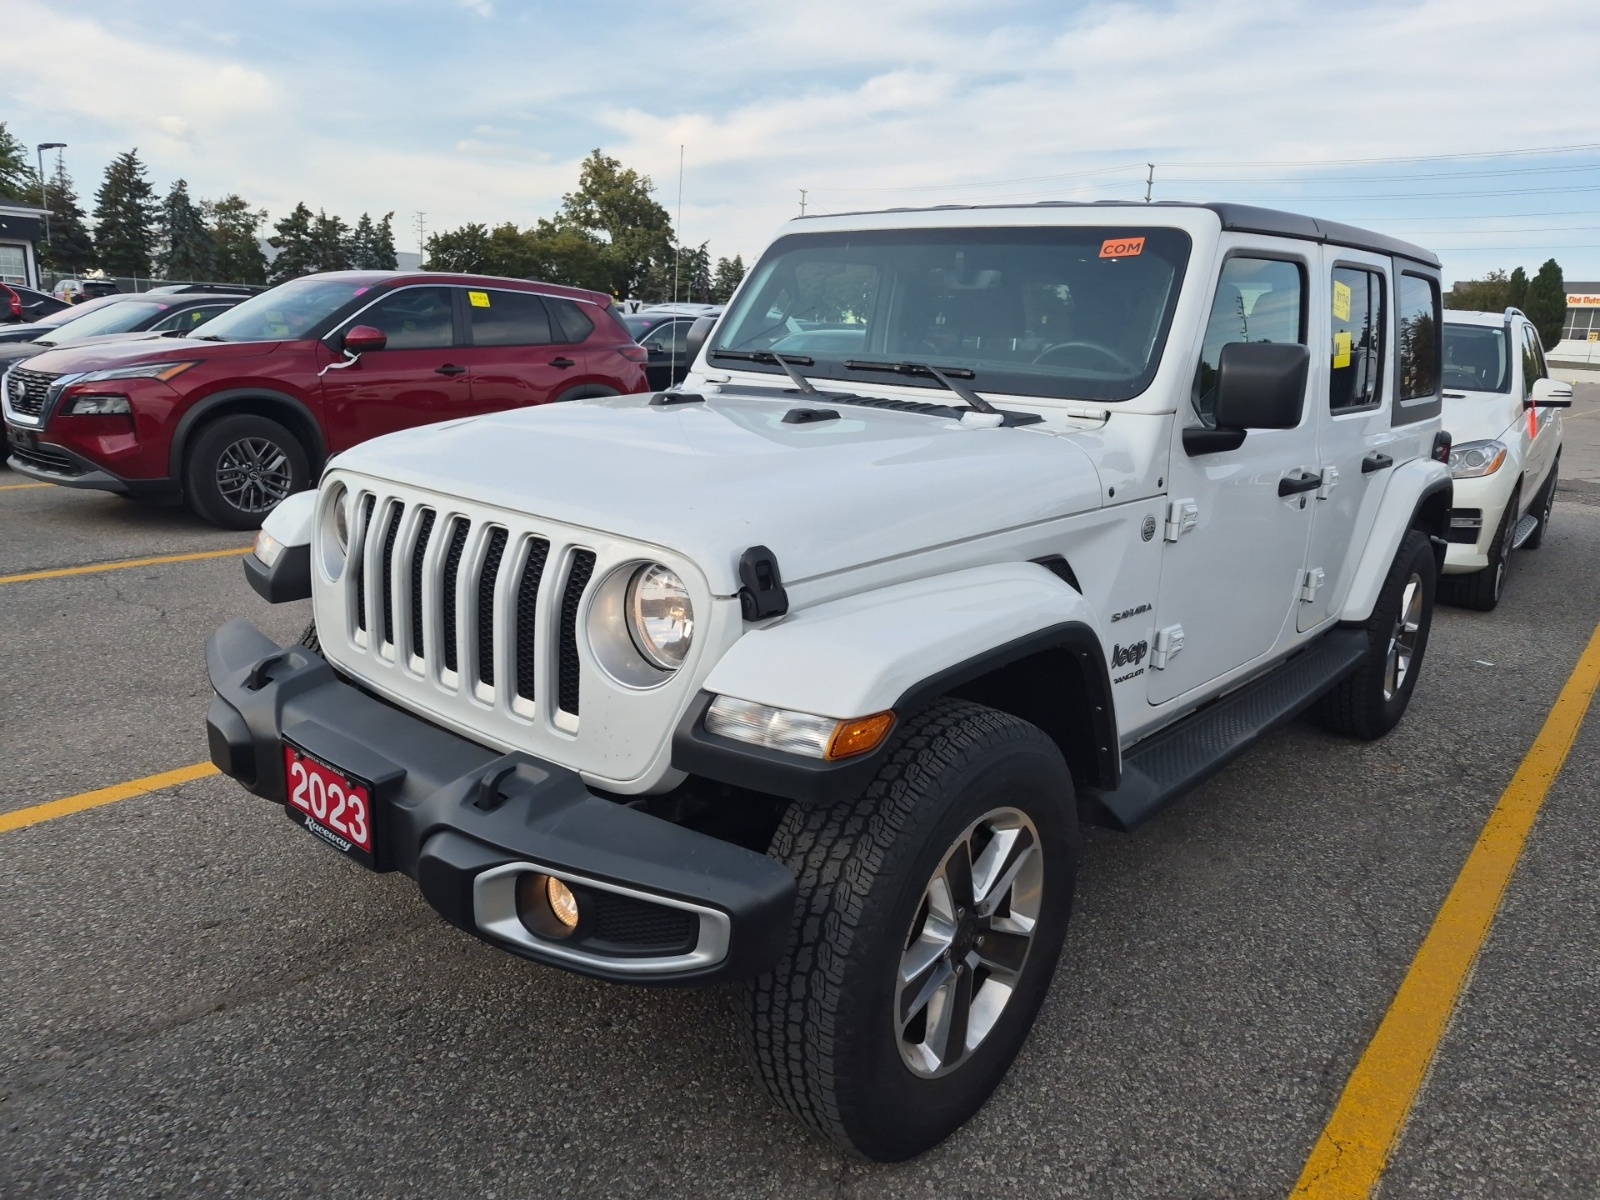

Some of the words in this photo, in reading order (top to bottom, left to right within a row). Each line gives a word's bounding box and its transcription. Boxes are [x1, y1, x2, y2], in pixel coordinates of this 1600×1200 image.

[1103, 242, 1141, 254] COM
[629, 302, 641, 314] Y
[1568, 295, 1581, 304] Old
[1111, 603, 1152, 623] SAHARA
[1111, 640, 1148, 669] Jeep
[291, 761, 368, 844] 2023
[304, 813, 352, 852] Raceway
